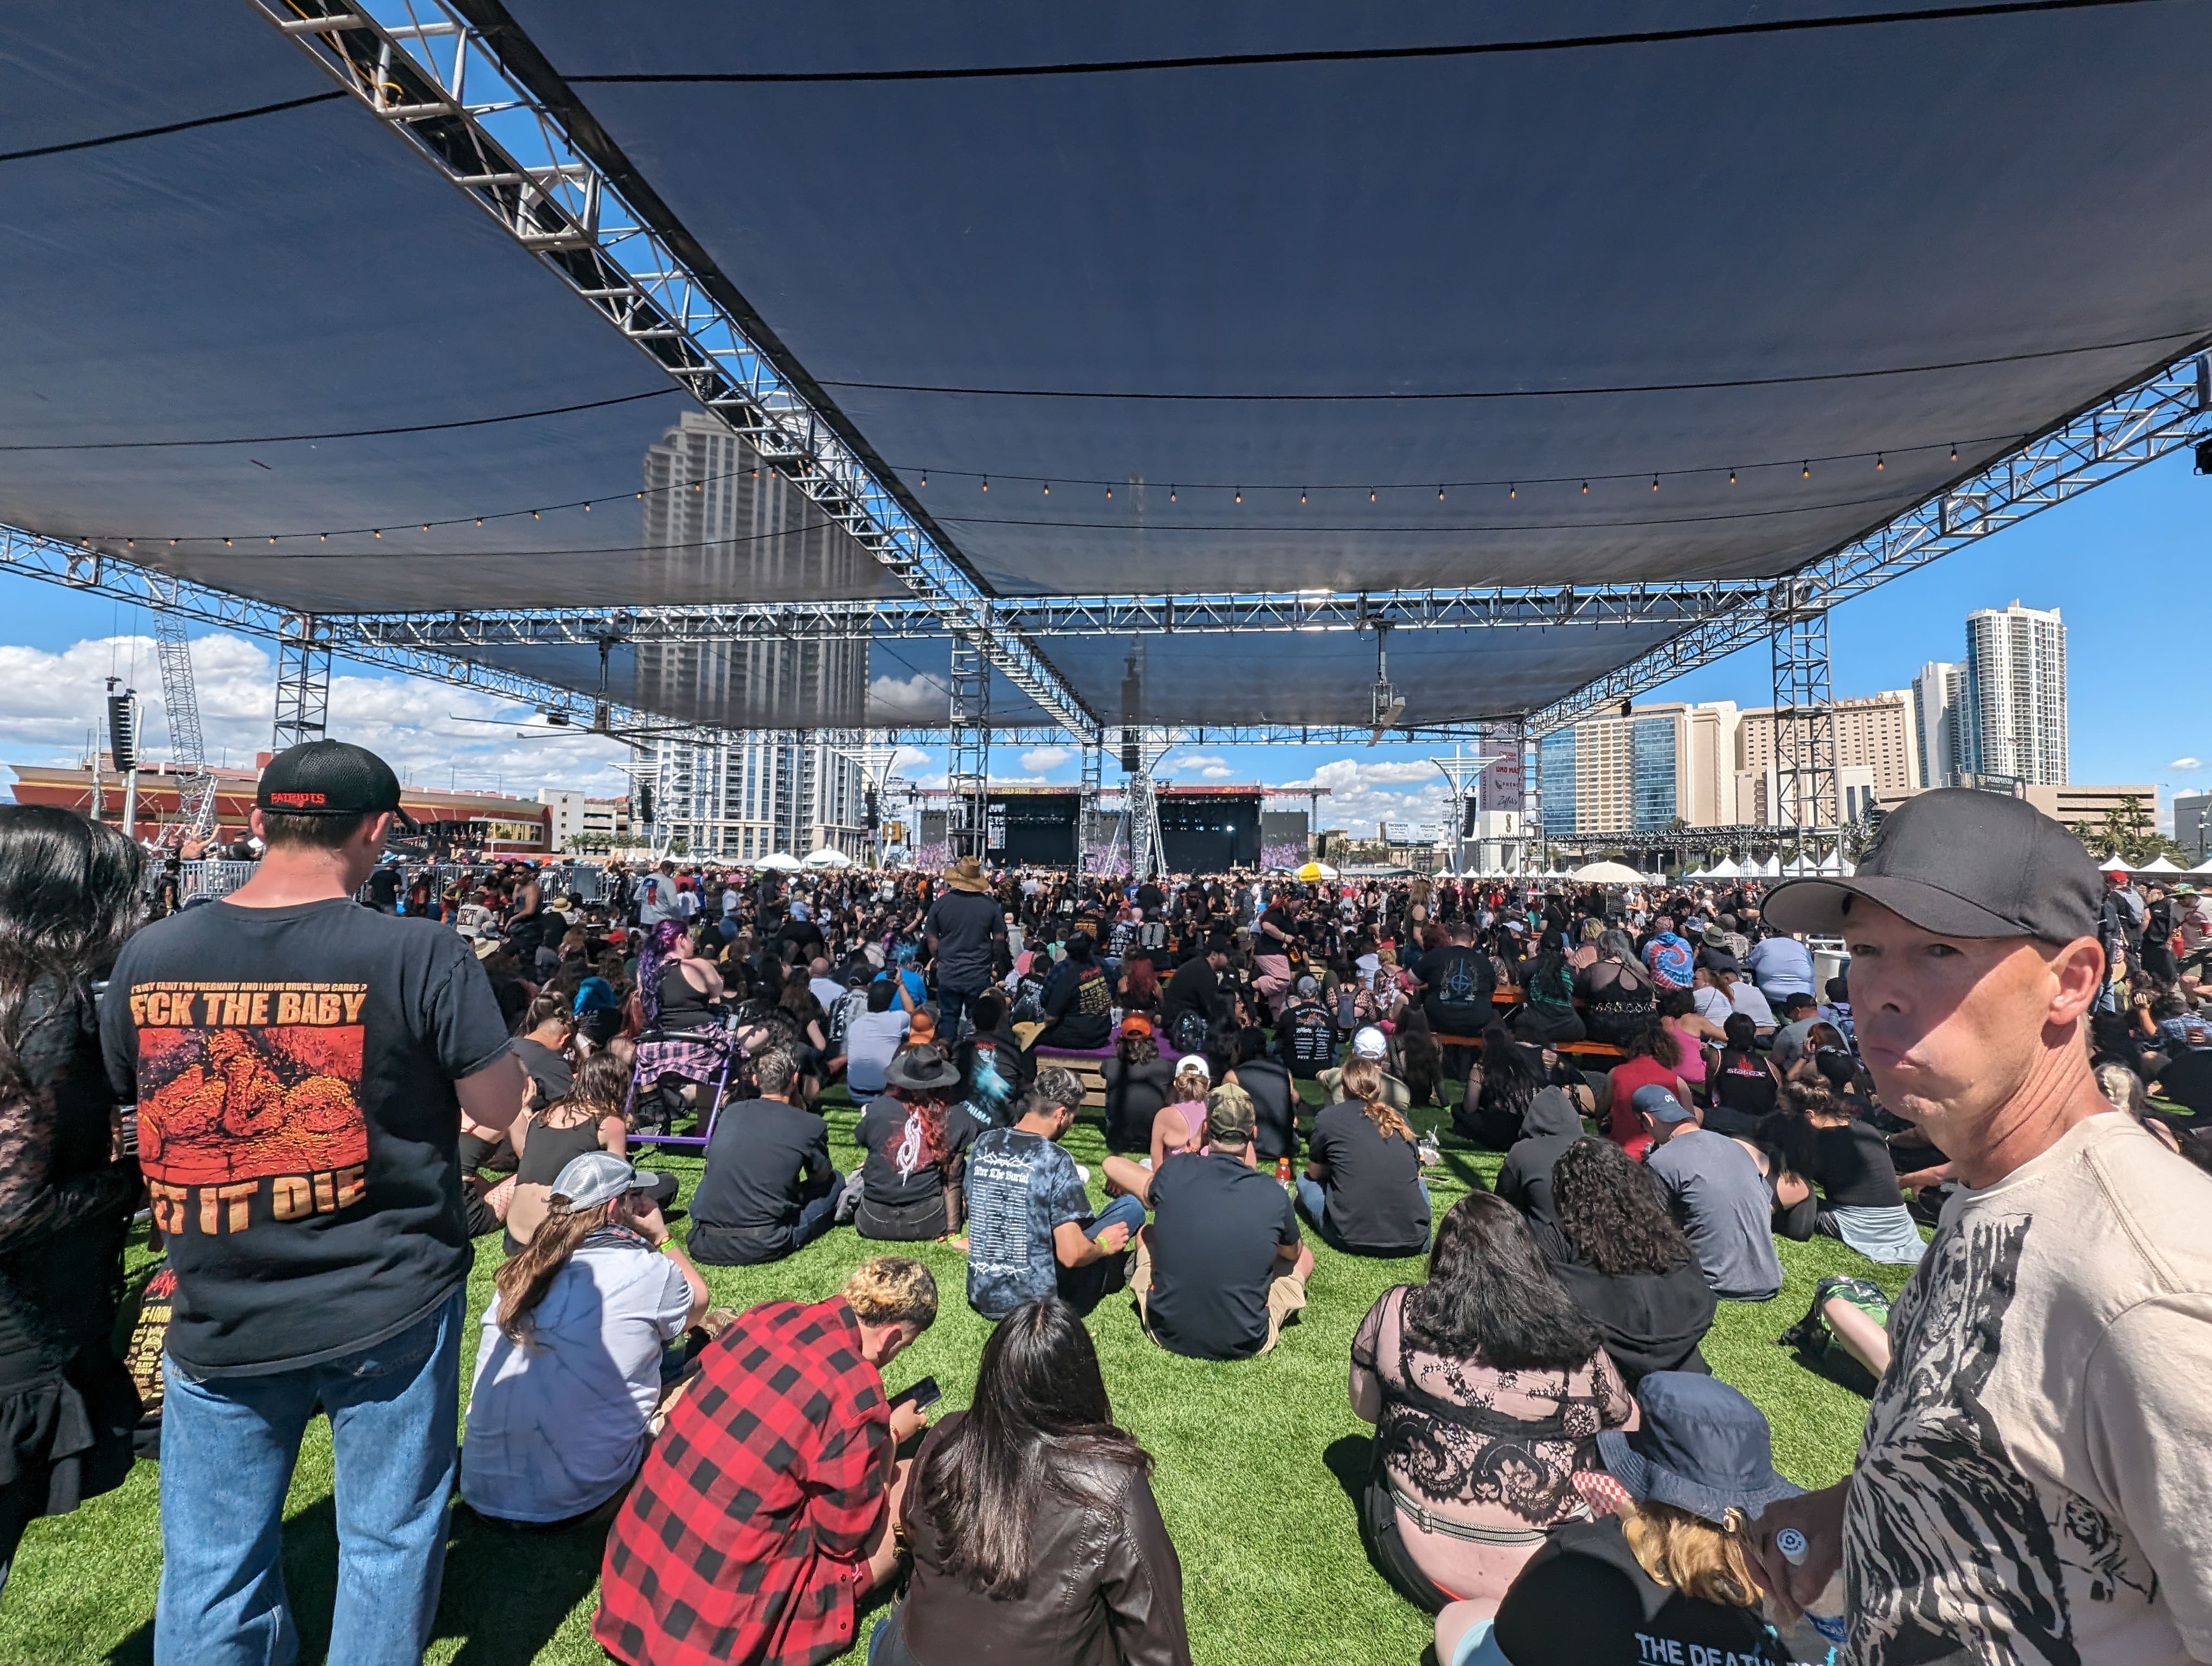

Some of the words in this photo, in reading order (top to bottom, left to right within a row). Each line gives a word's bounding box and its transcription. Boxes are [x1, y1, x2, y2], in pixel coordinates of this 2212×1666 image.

[1986, 776, 2014, 785] POMPONIO
[271, 792, 326, 805] PATRIOTS
[156, 982, 179, 991] FAULT
[179, 982, 193, 991] I'M
[194, 982, 240, 991] PREGNANT
[240, 982, 259, 991] AND
[263, 982, 285, 991] LOVE
[312, 983, 330, 992] WHO
[331, 983, 360, 992] CARES
[203, 992, 269, 1025] THE
[276, 992, 366, 1024] BABY
[974, 1165, 988, 1177] After
[989, 1168, 1005, 1180] The
[1005, 1171, 1030, 1184] Burial
[199, 1181, 259, 1235] IT
[273, 1164, 366, 1221] DIE
[1635, 1632, 1684, 1666] THE
